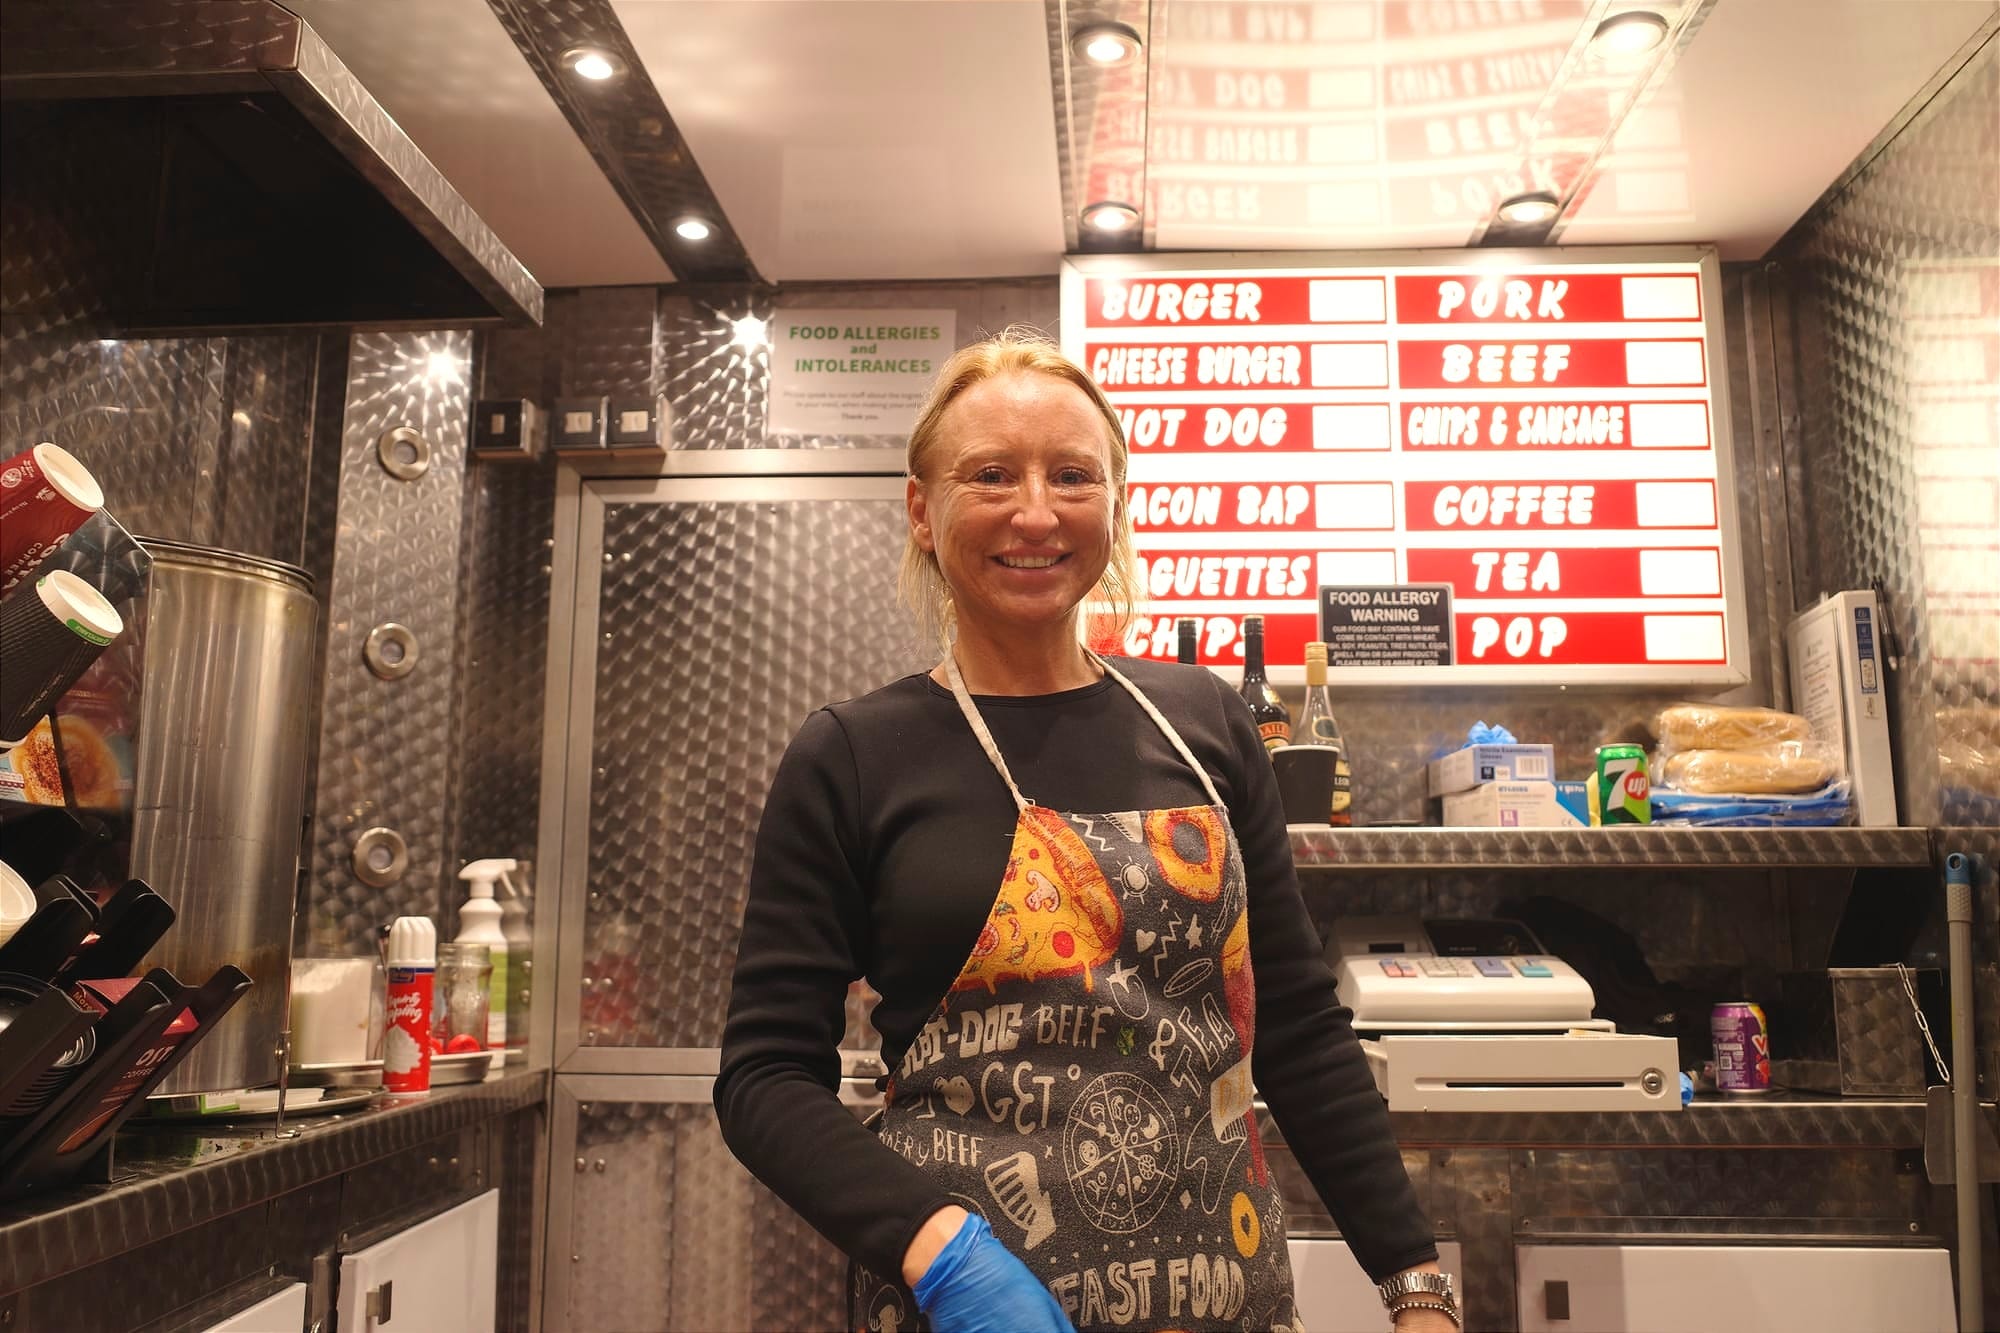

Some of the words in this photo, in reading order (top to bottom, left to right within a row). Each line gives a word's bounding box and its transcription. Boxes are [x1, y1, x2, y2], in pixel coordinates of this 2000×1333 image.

[1102, 282, 1262, 323] BURGER
[1438, 280, 1569, 320] PORK
[789, 326, 839, 341] FOOD
[843, 326, 941, 341] ALLERGIES
[850, 344, 877, 355] and
[795, 359, 932, 374] INTOLERANCES
[1093, 347, 1188, 385] CHEESE
[1197, 345, 1302, 386] BURGER
[1442, 344, 1571, 383] BEEF
[1203, 407, 1288, 447] DOG
[1408, 406, 1480, 446] CHIPS
[1489, 405, 1508, 445] &
[1516, 405, 1625, 445] SAUSAGE
[1129, 486, 1222, 526] ACON
[1236, 485, 1310, 526] BAP
[1433, 485, 1595, 526] COFFEE
[1471, 551, 1561, 592] TEA
[1329, 591, 1370, 606] FOOD
[1372, 591, 1440, 606] ALLERGY
[1350, 608, 1420, 622] WARNING
[1471, 616, 1568, 658] POP
[1603, 757, 1639, 811] 7
[1036, 1003, 1115, 1049] BEEF
[1169, 992, 1236, 1100] TEA
[980, 1060, 1056, 1136] GET
[933, 1127, 984, 1168] BEEF
[1048, 1258, 1157, 1328] FAST
[1167, 1253, 1246, 1322] FOOD
